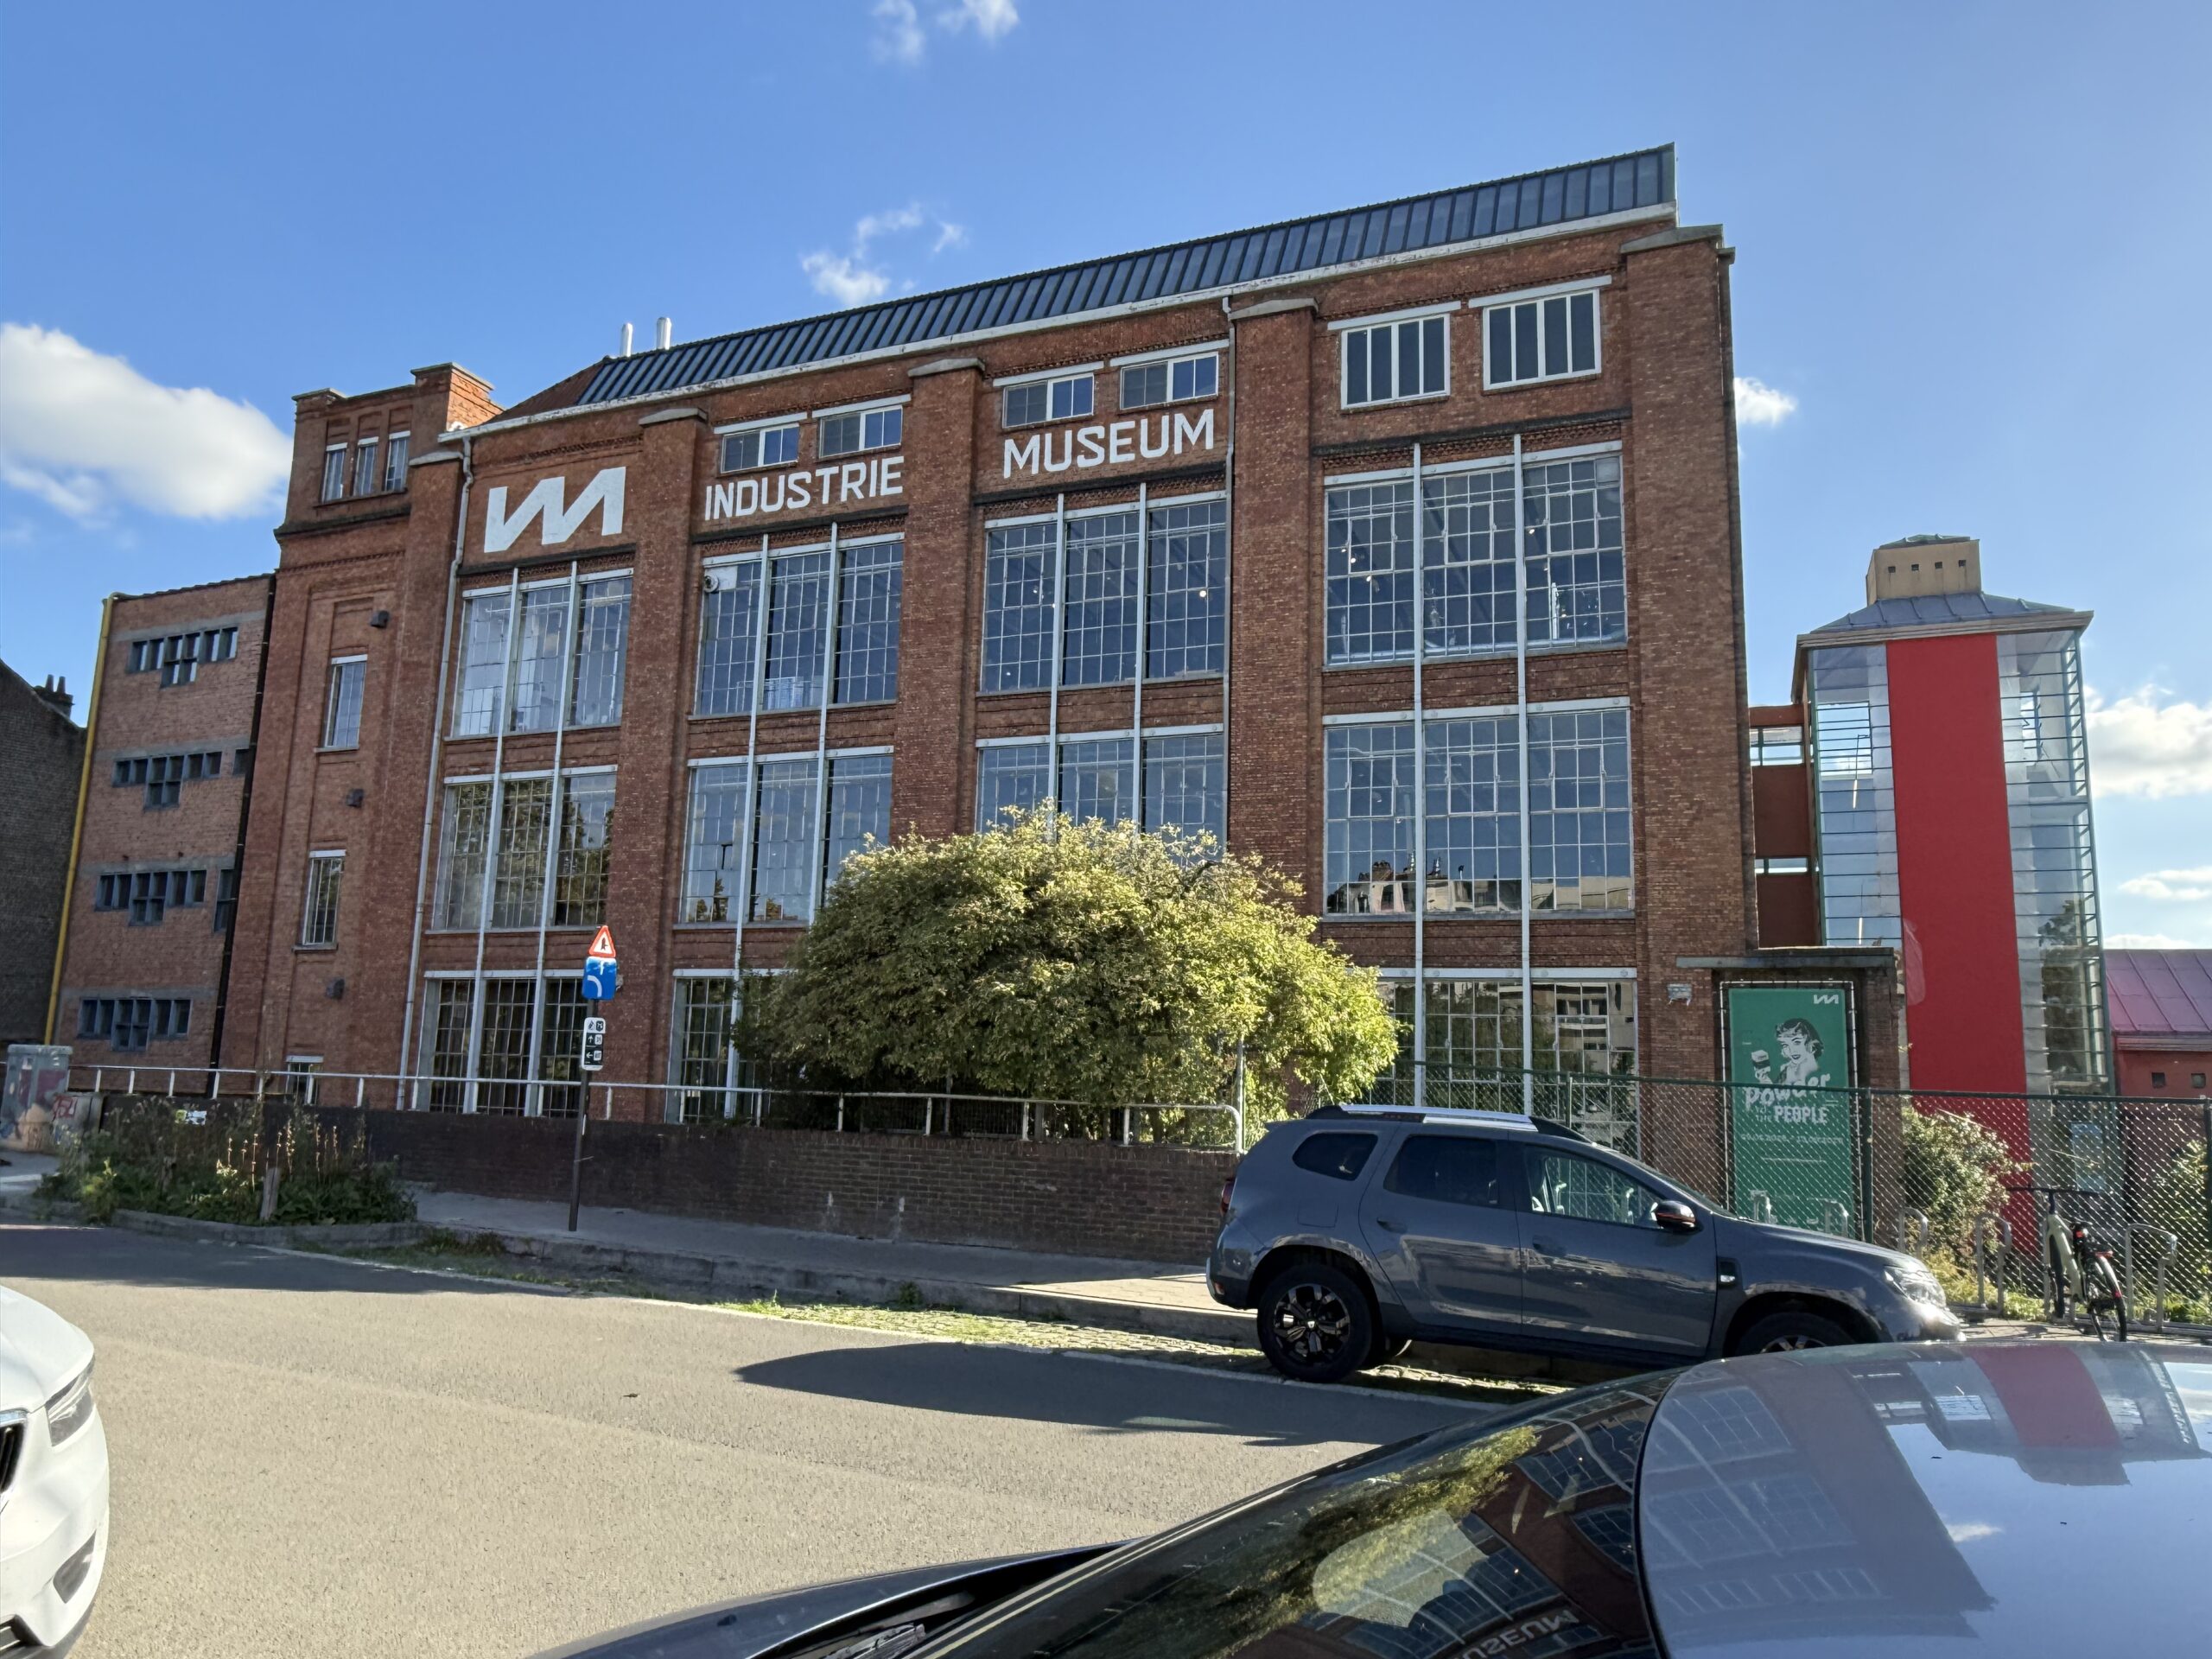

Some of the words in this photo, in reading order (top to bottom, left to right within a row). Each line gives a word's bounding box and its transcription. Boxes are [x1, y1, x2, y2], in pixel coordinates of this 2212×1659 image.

[1002, 409, 1214, 480] MUSEUM
[705, 457, 905, 520] INDUSTRIE
[1774, 1105, 1829, 1124] PEOPLE
